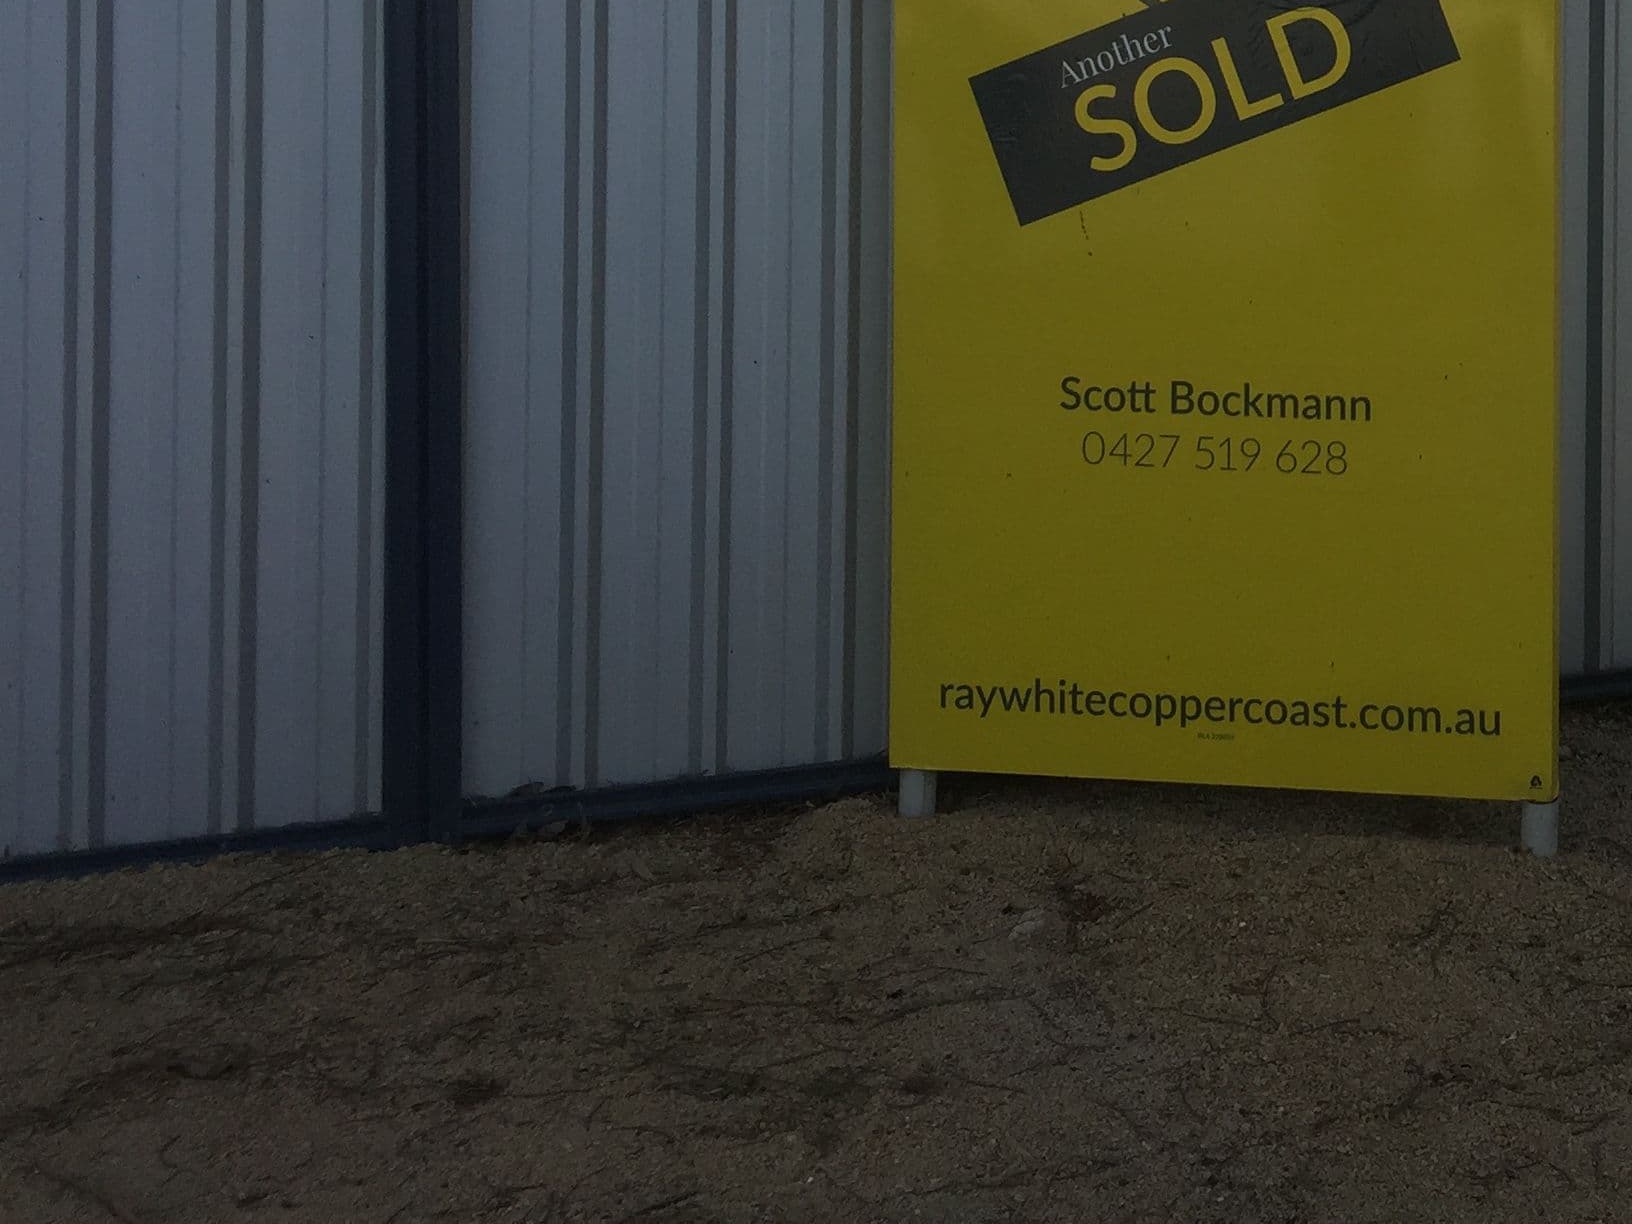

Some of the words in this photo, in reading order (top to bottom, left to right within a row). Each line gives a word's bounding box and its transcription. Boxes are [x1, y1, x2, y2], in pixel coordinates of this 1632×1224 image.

[1060, 25, 1173, 88] Another
[1075, 6, 1351, 172] SOLD
[1060, 376, 1156, 413] Scott
[1171, 380, 1371, 421] Bockmann
[1082, 431, 1181, 468] 0427
[1195, 436, 1261, 472] 519
[1275, 439, 1348, 476] 628
[939, 678, 1501, 736] raywhitecoppercoast.com.au
